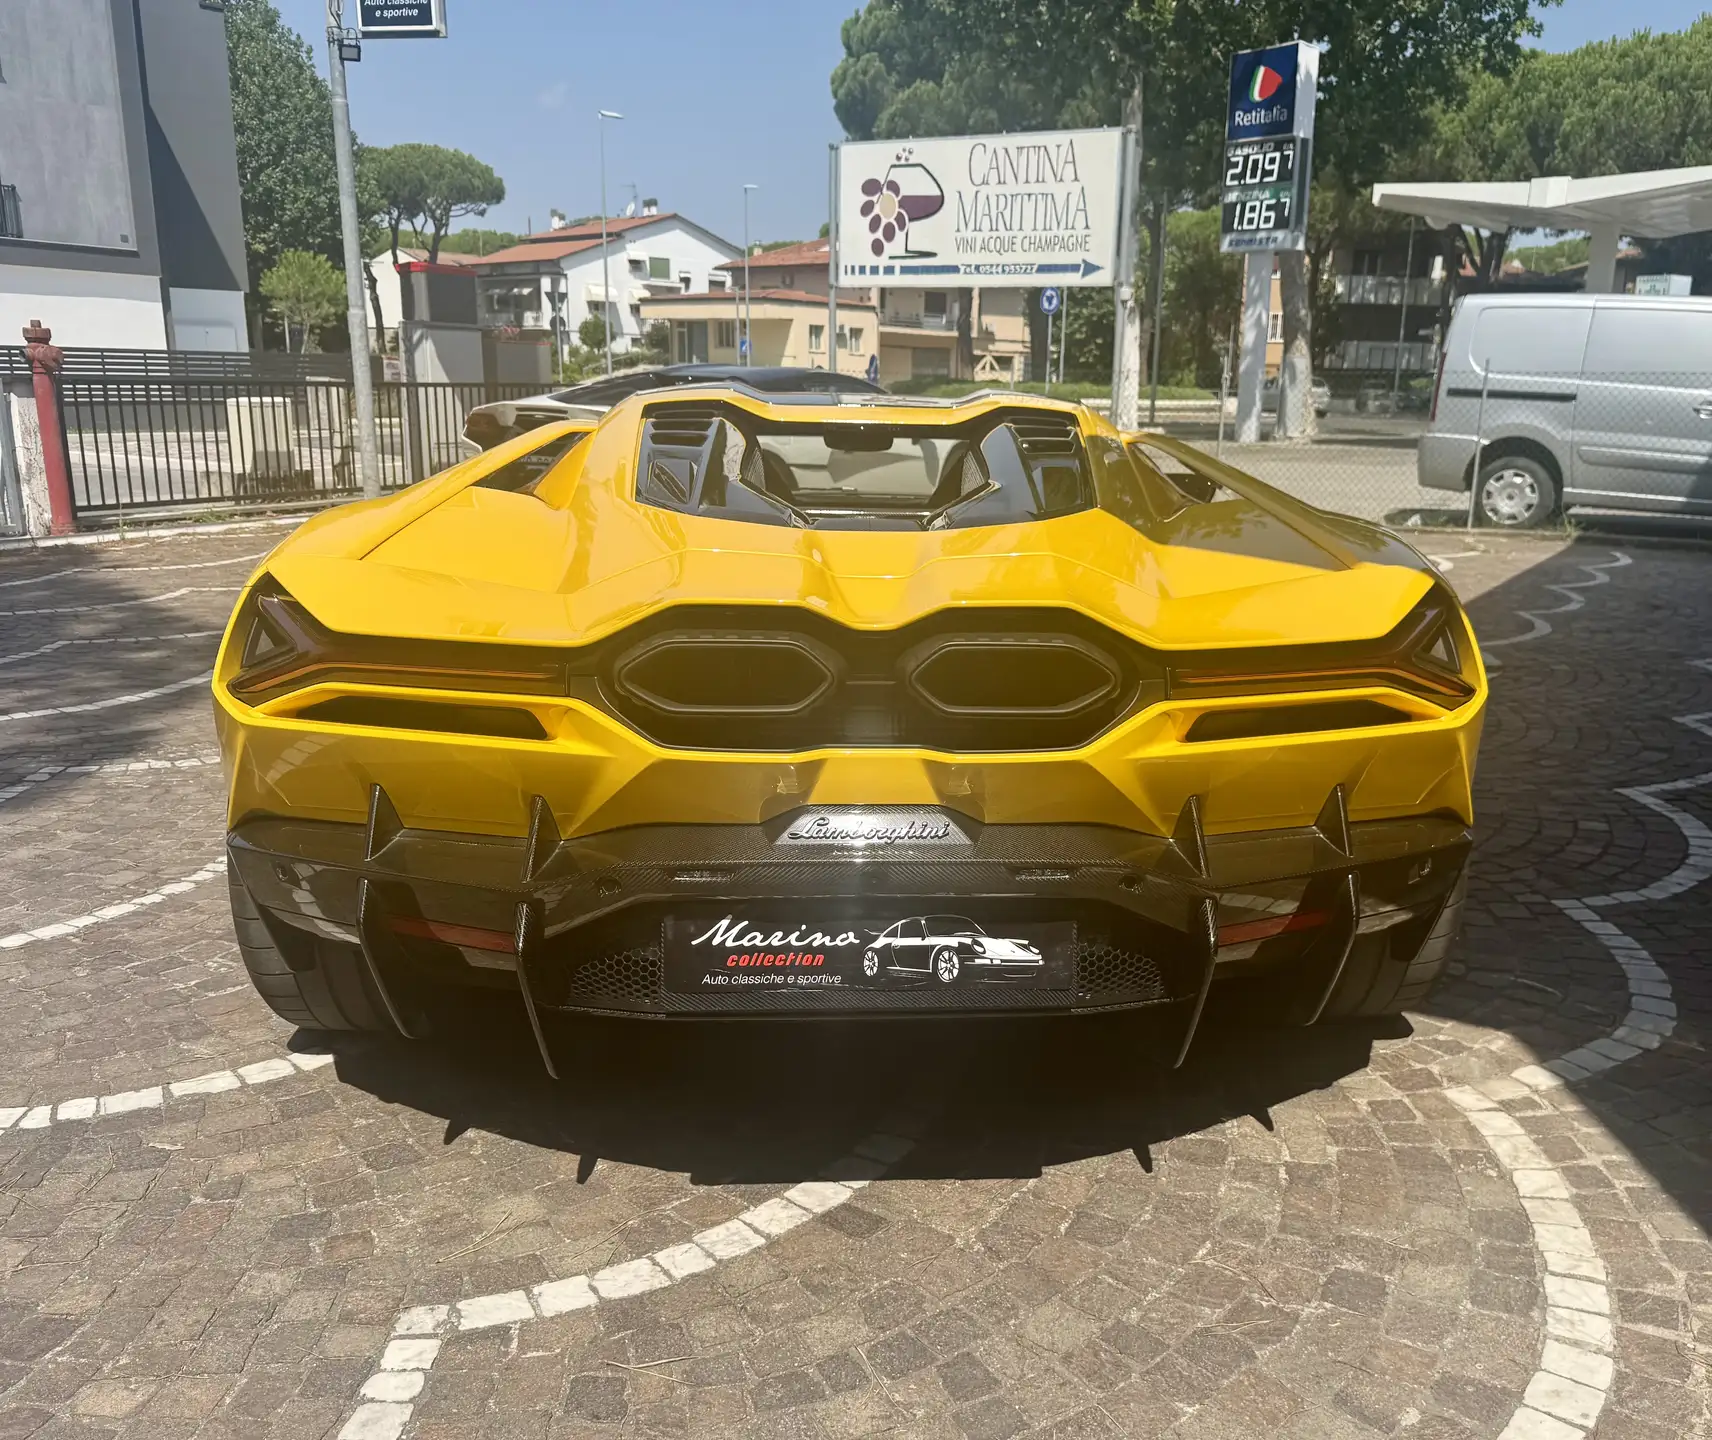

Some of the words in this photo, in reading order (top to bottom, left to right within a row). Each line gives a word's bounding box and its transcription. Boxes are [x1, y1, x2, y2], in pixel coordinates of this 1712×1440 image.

[383, 8, 418, 17] sportive
[1234, 104, 1288, 127] Retitalia
[968, 138, 1080, 187] CANTINA
[955, 186, 1091, 233] MARITTIMA
[954, 236, 977, 254] VINI
[979, 235, 1017, 256] ACQUE
[1020, 234, 1091, 253] CHAMPAGNE
[788, 817, 952, 844] Lamborghini
[691, 915, 860, 948] Marino
[726, 952, 824, 968] collection
[702, 974, 729, 984] Auto
[731, 973, 784, 985] classiche
[787, 976, 795, 984] e
[797, 974, 842, 988] sportive
